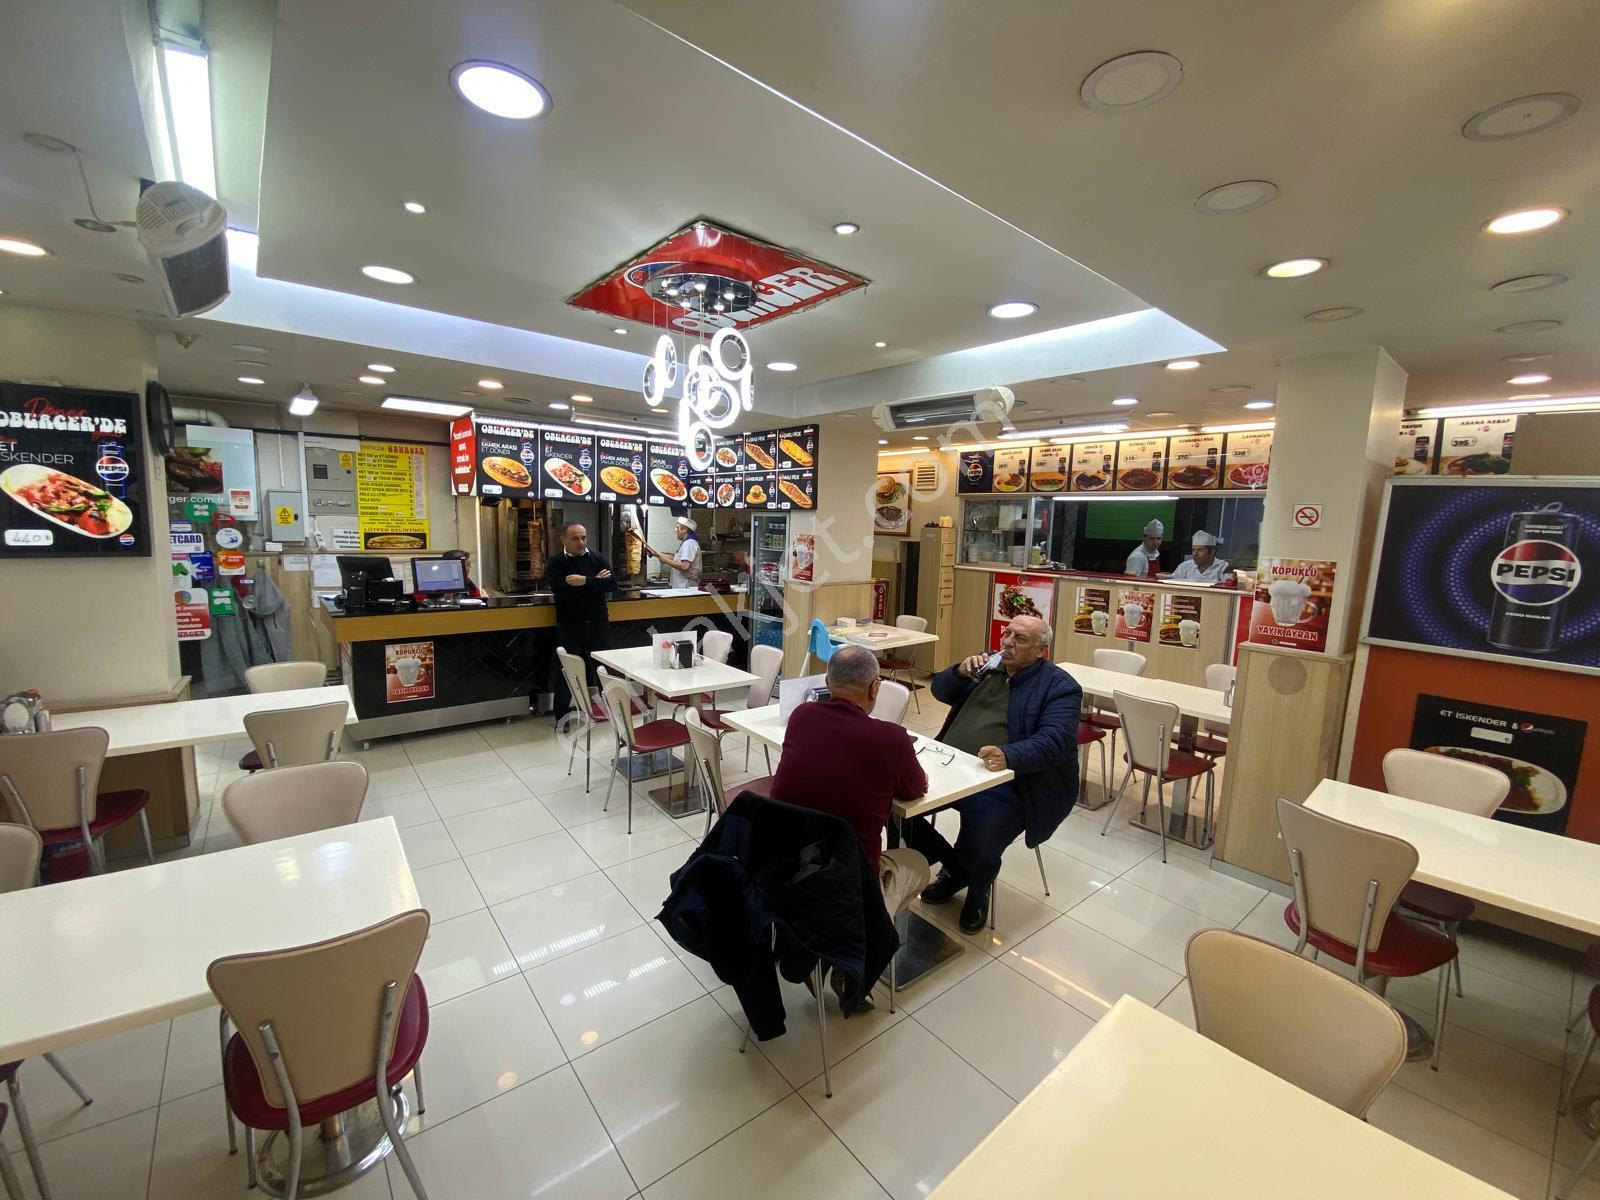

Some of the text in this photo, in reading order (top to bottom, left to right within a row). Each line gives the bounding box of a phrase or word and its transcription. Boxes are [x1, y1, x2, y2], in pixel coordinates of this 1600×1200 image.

[1, 452, 74, 465] SKENDER
[97, 464, 128, 472] PEPSI
[1496, 563, 1576, 582] PEPSI
[1284, 628, 1319, 641] AYRAN
[1440, 709, 1454, 718] ET
[1455, 712, 1508, 728] İSKENDER
[1511, 722, 1519, 730] &
